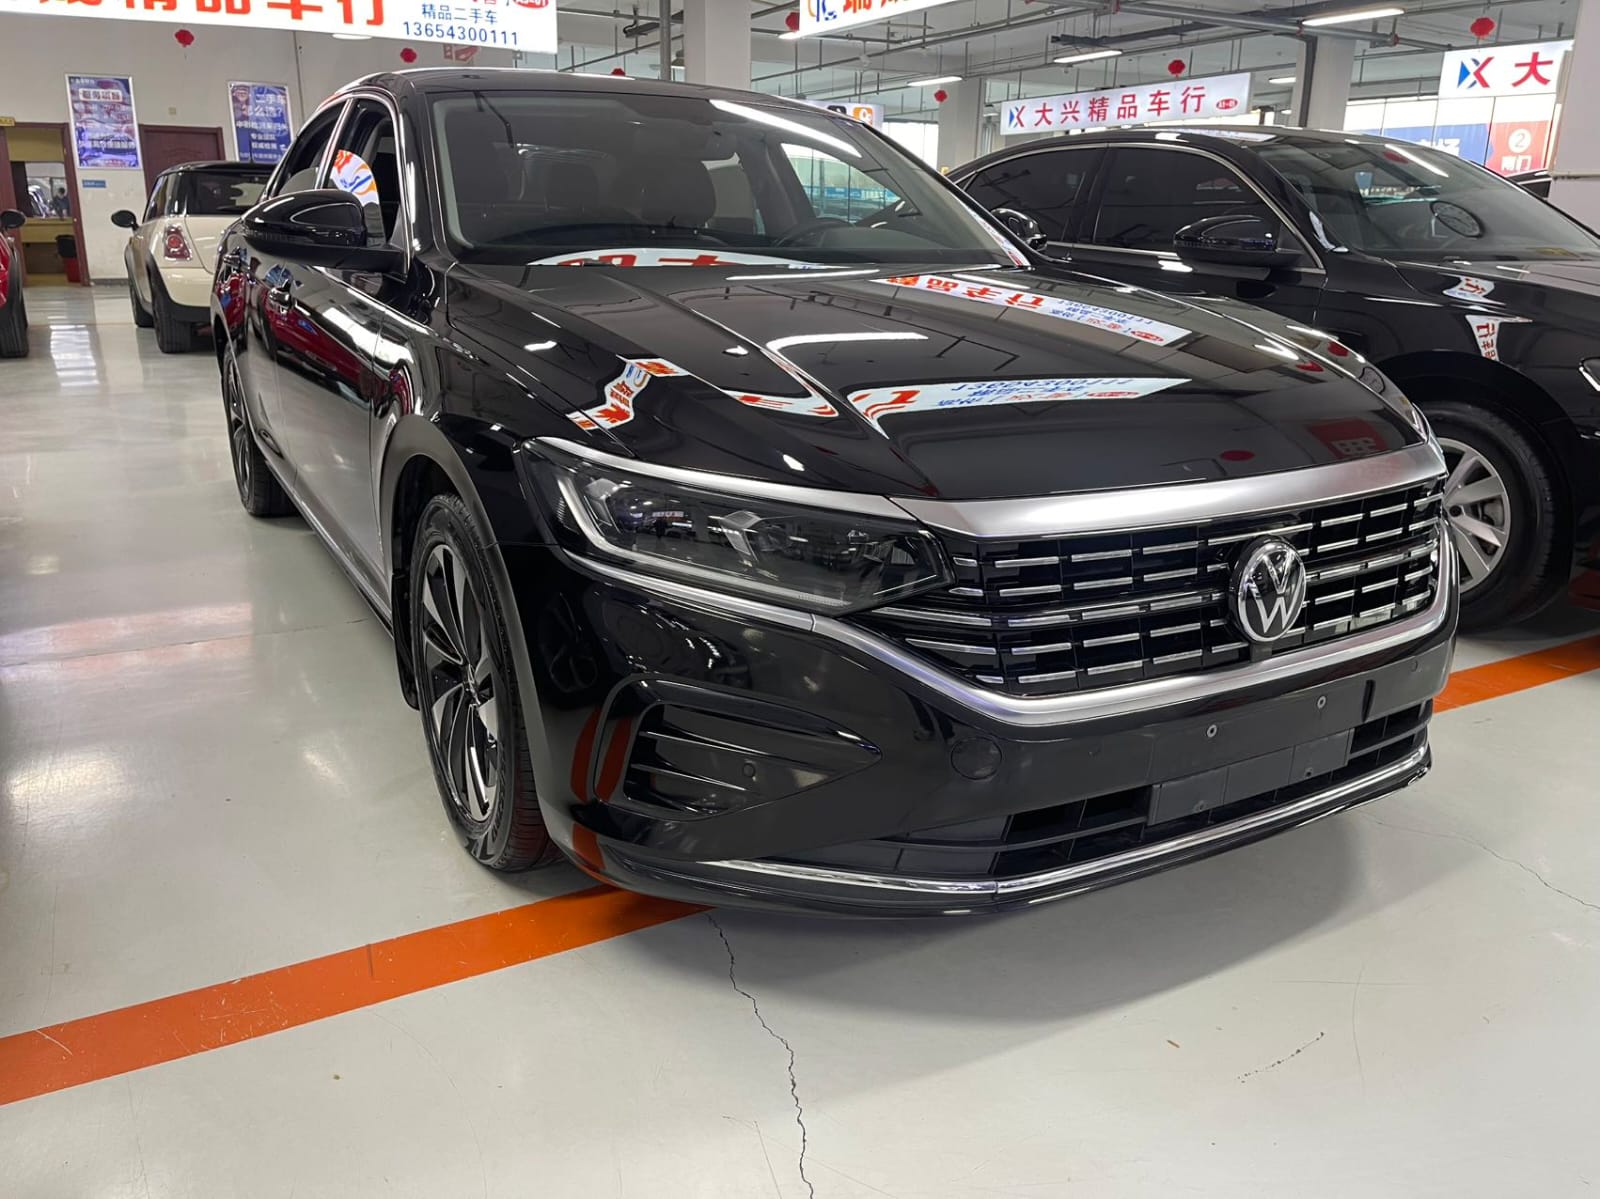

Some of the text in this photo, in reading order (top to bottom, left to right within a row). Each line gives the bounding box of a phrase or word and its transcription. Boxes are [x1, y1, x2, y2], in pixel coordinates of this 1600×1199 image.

[421, 3, 498, 25] 精品二手车
[403, 21, 518, 45] 13654300111
[1511, 51, 1554, 88] 大
[1033, 84, 1206, 128] 大兴精品车行
